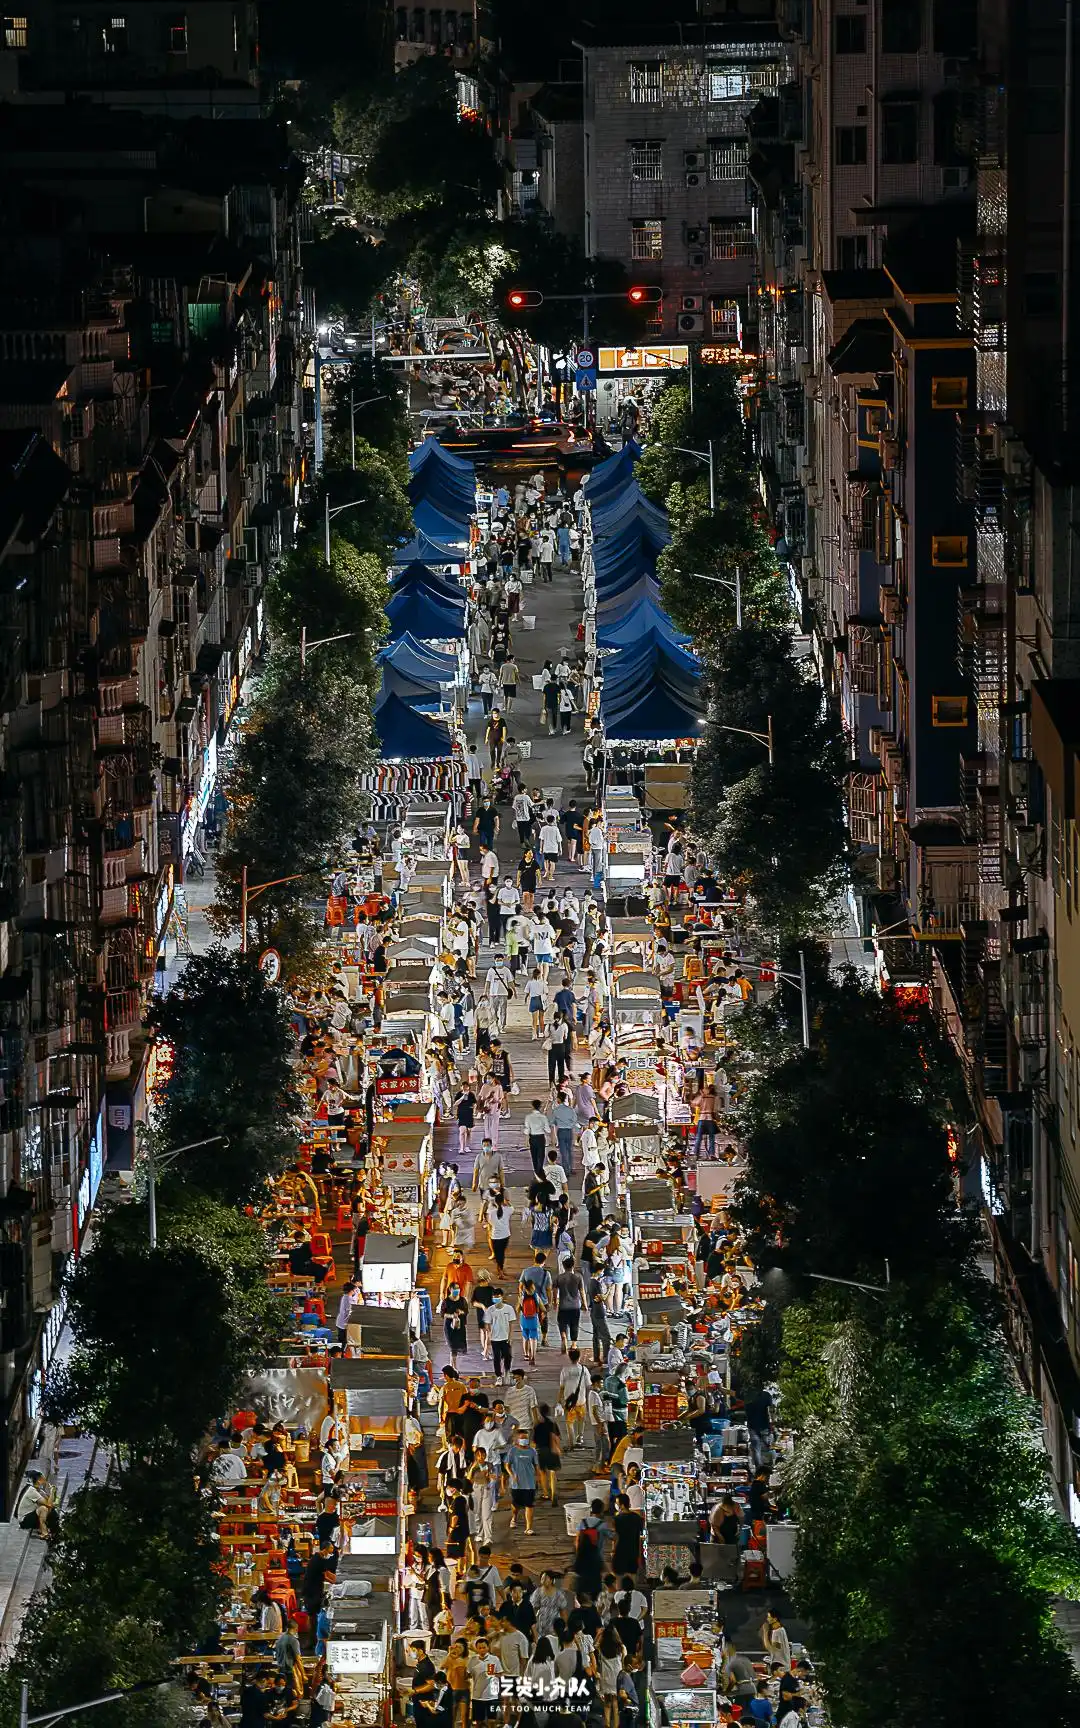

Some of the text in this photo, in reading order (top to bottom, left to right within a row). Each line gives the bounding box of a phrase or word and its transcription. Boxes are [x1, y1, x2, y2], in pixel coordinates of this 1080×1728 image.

[579, 354, 592, 363] 20
[380, 1079, 418, 1090] 农家小炒
